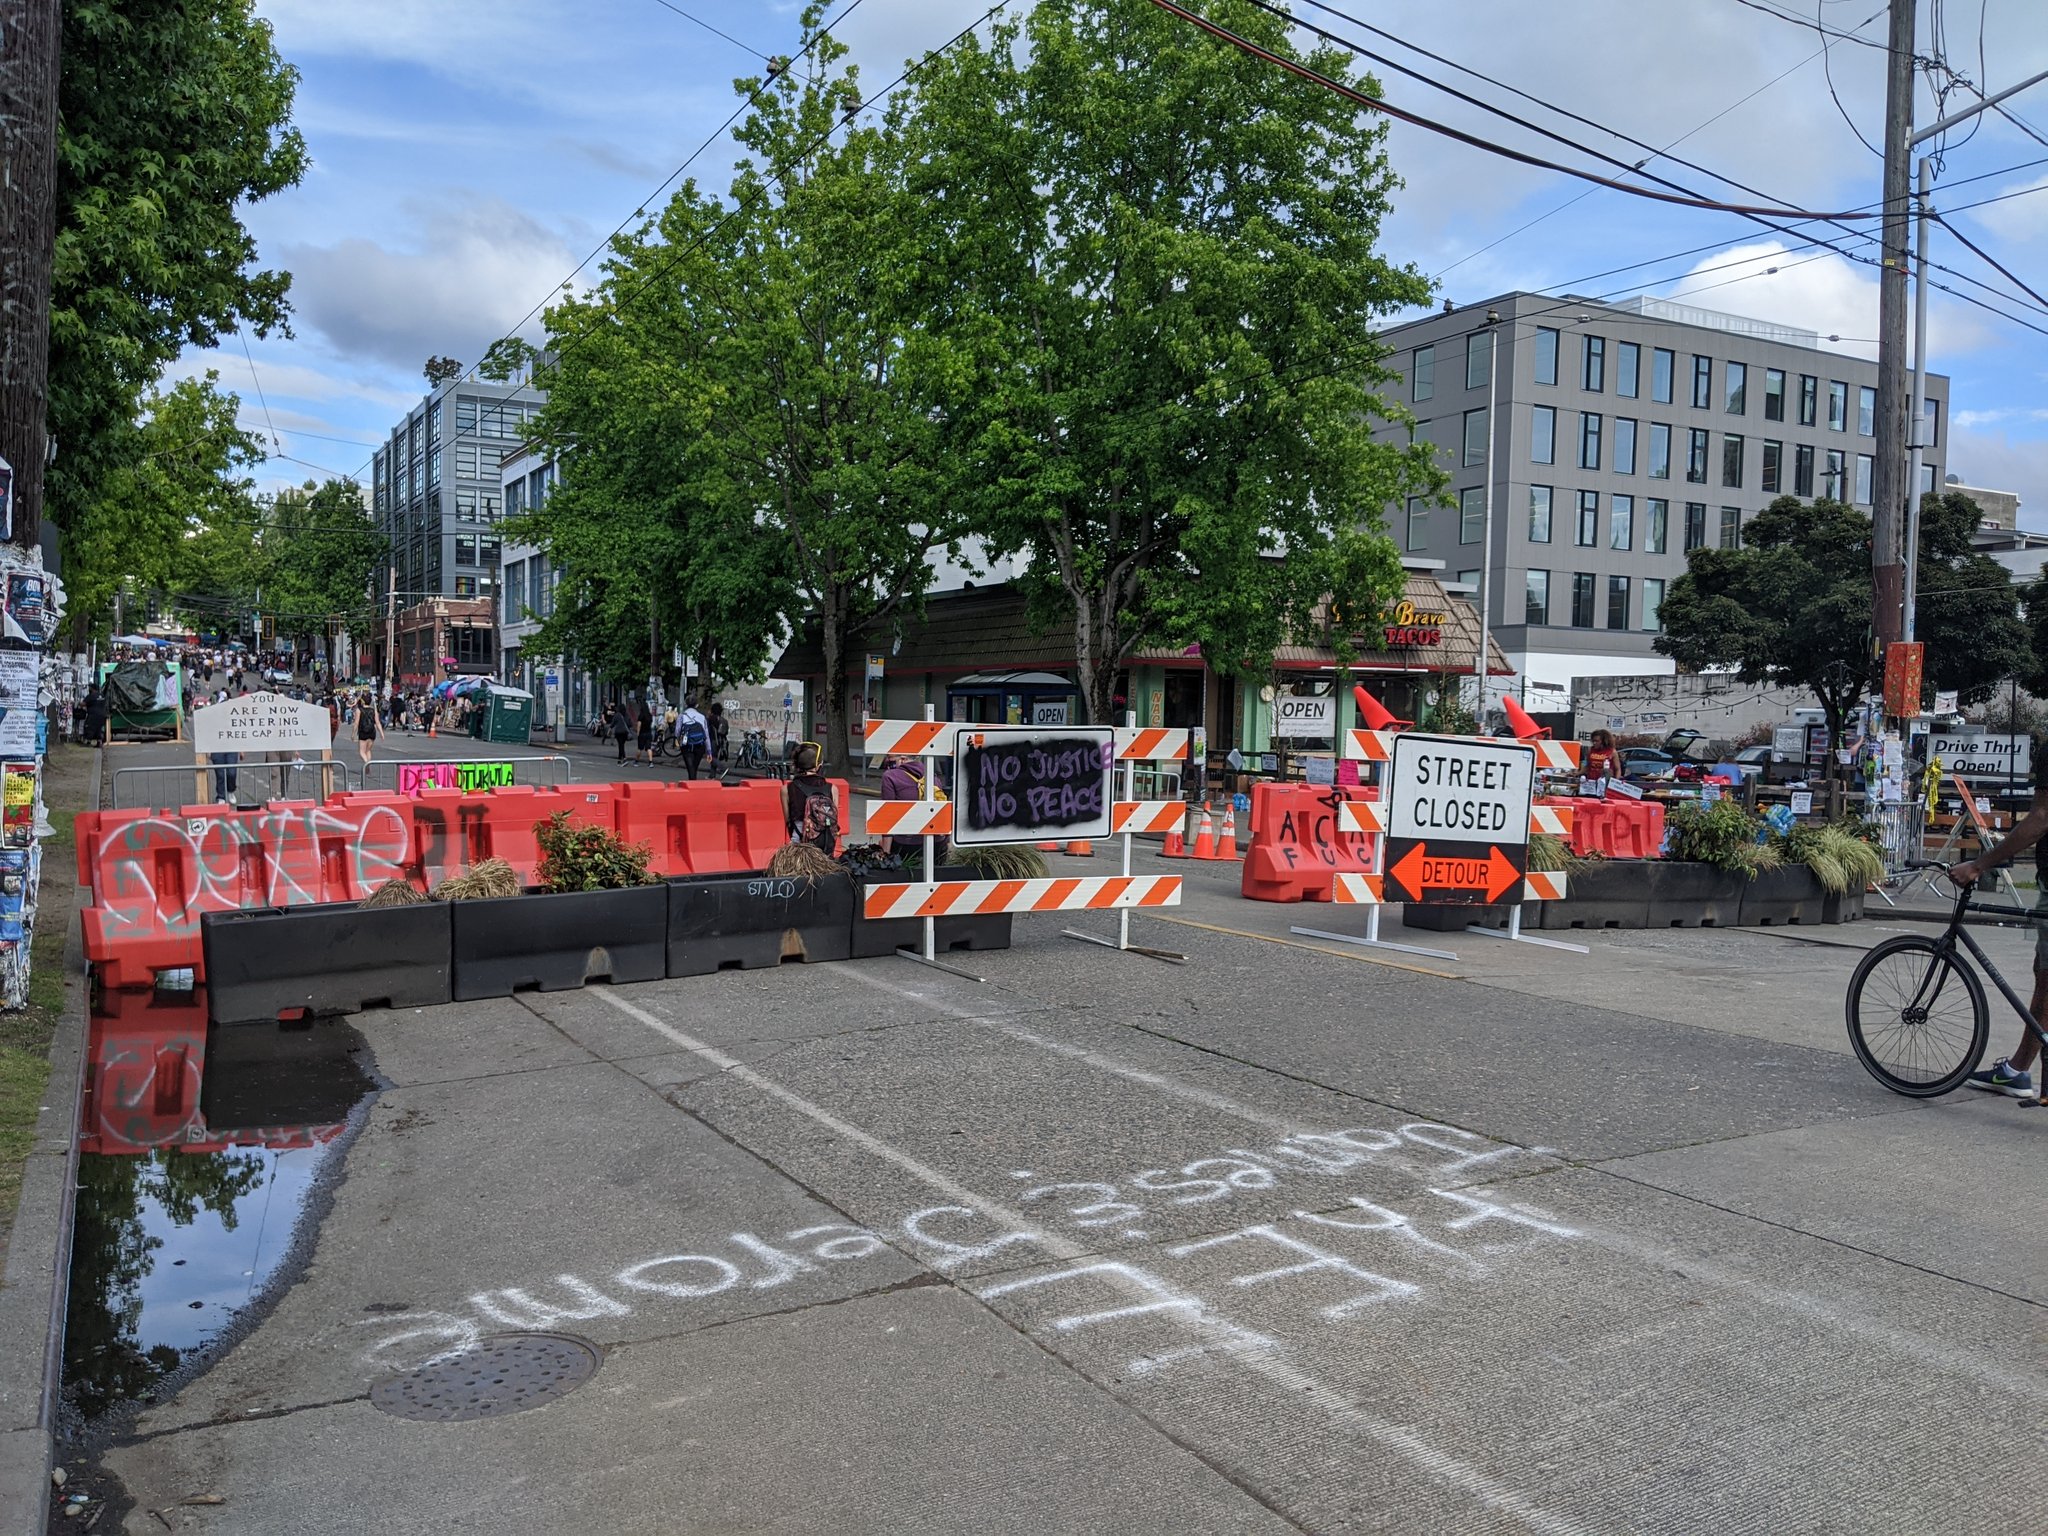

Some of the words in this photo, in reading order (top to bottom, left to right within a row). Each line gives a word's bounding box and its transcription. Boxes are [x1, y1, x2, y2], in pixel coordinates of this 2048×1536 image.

[1396, 600, 1446, 626] Bravo
[1386, 628, 1441, 645] TACOS
[251, 695, 275, 703] YOU
[230, 706, 258, 715] ARE
[269, 706, 299, 715] NOW
[1038, 708, 1064, 722] OPEN
[1283, 702, 1325, 717] OPEN
[231, 717, 299, 727] ENTERING
[218, 731, 247, 739] FREE
[252, 729, 272, 738] CAP
[279, 729, 308, 738] HILL
[1935, 740, 1978, 753] Drive
[1984, 740, 2021, 754] Thru
[981, 753, 1021, 787] NO
[1028, 742, 1117, 780] JUSTICE
[1416, 755, 1512, 791] STREET
[1953, 760, 2002, 772] Open!
[978, 786, 1017, 826] NO
[1027, 778, 1104, 822] PEACE
[1414, 797, 1507, 831] CLOSED
[1422, 861, 1489, 885] DETOUR
[345, 1204, 1042, 1372] Jerome
[975, 1183, 1590, 1378] FREE
